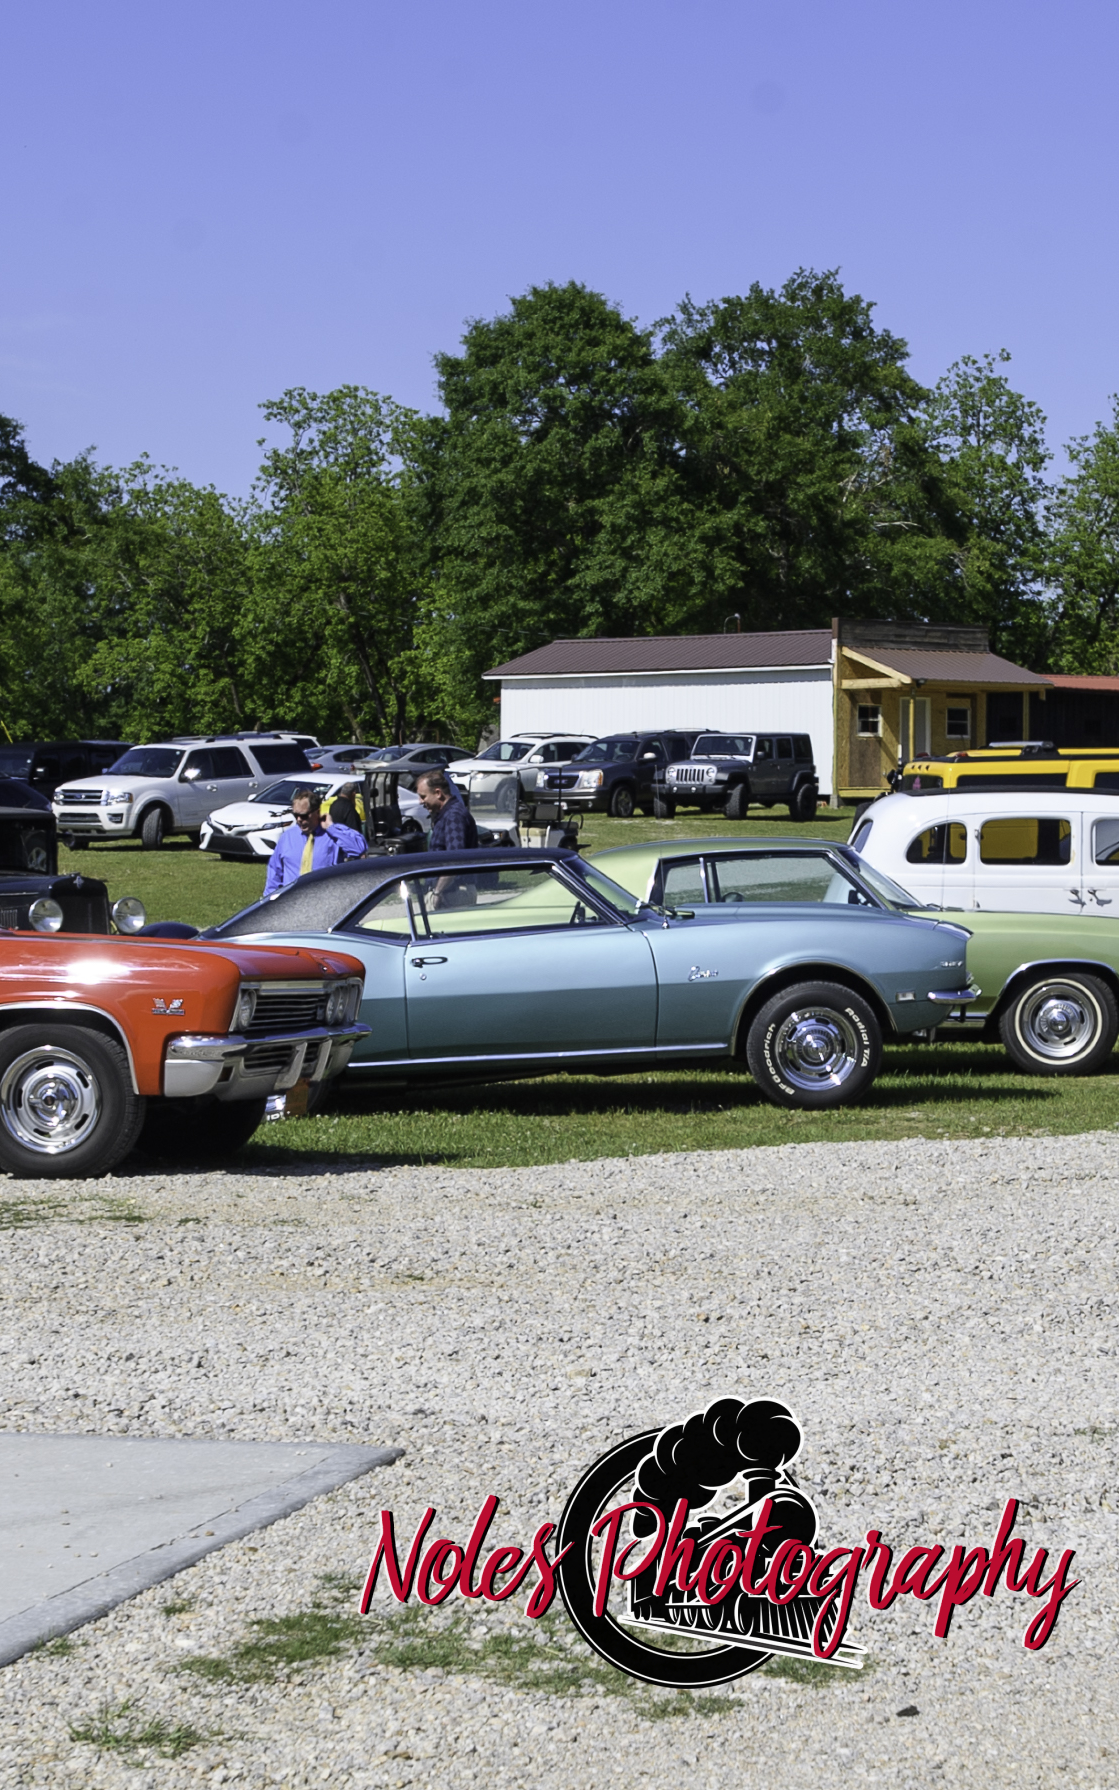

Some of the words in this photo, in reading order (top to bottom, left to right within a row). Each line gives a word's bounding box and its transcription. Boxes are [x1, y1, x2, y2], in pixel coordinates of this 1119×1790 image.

[764, 1023, 795, 1095] BFGoodrich
[844, 1007, 870, 1045] Radial
[861, 1048, 870, 1067] T/A
